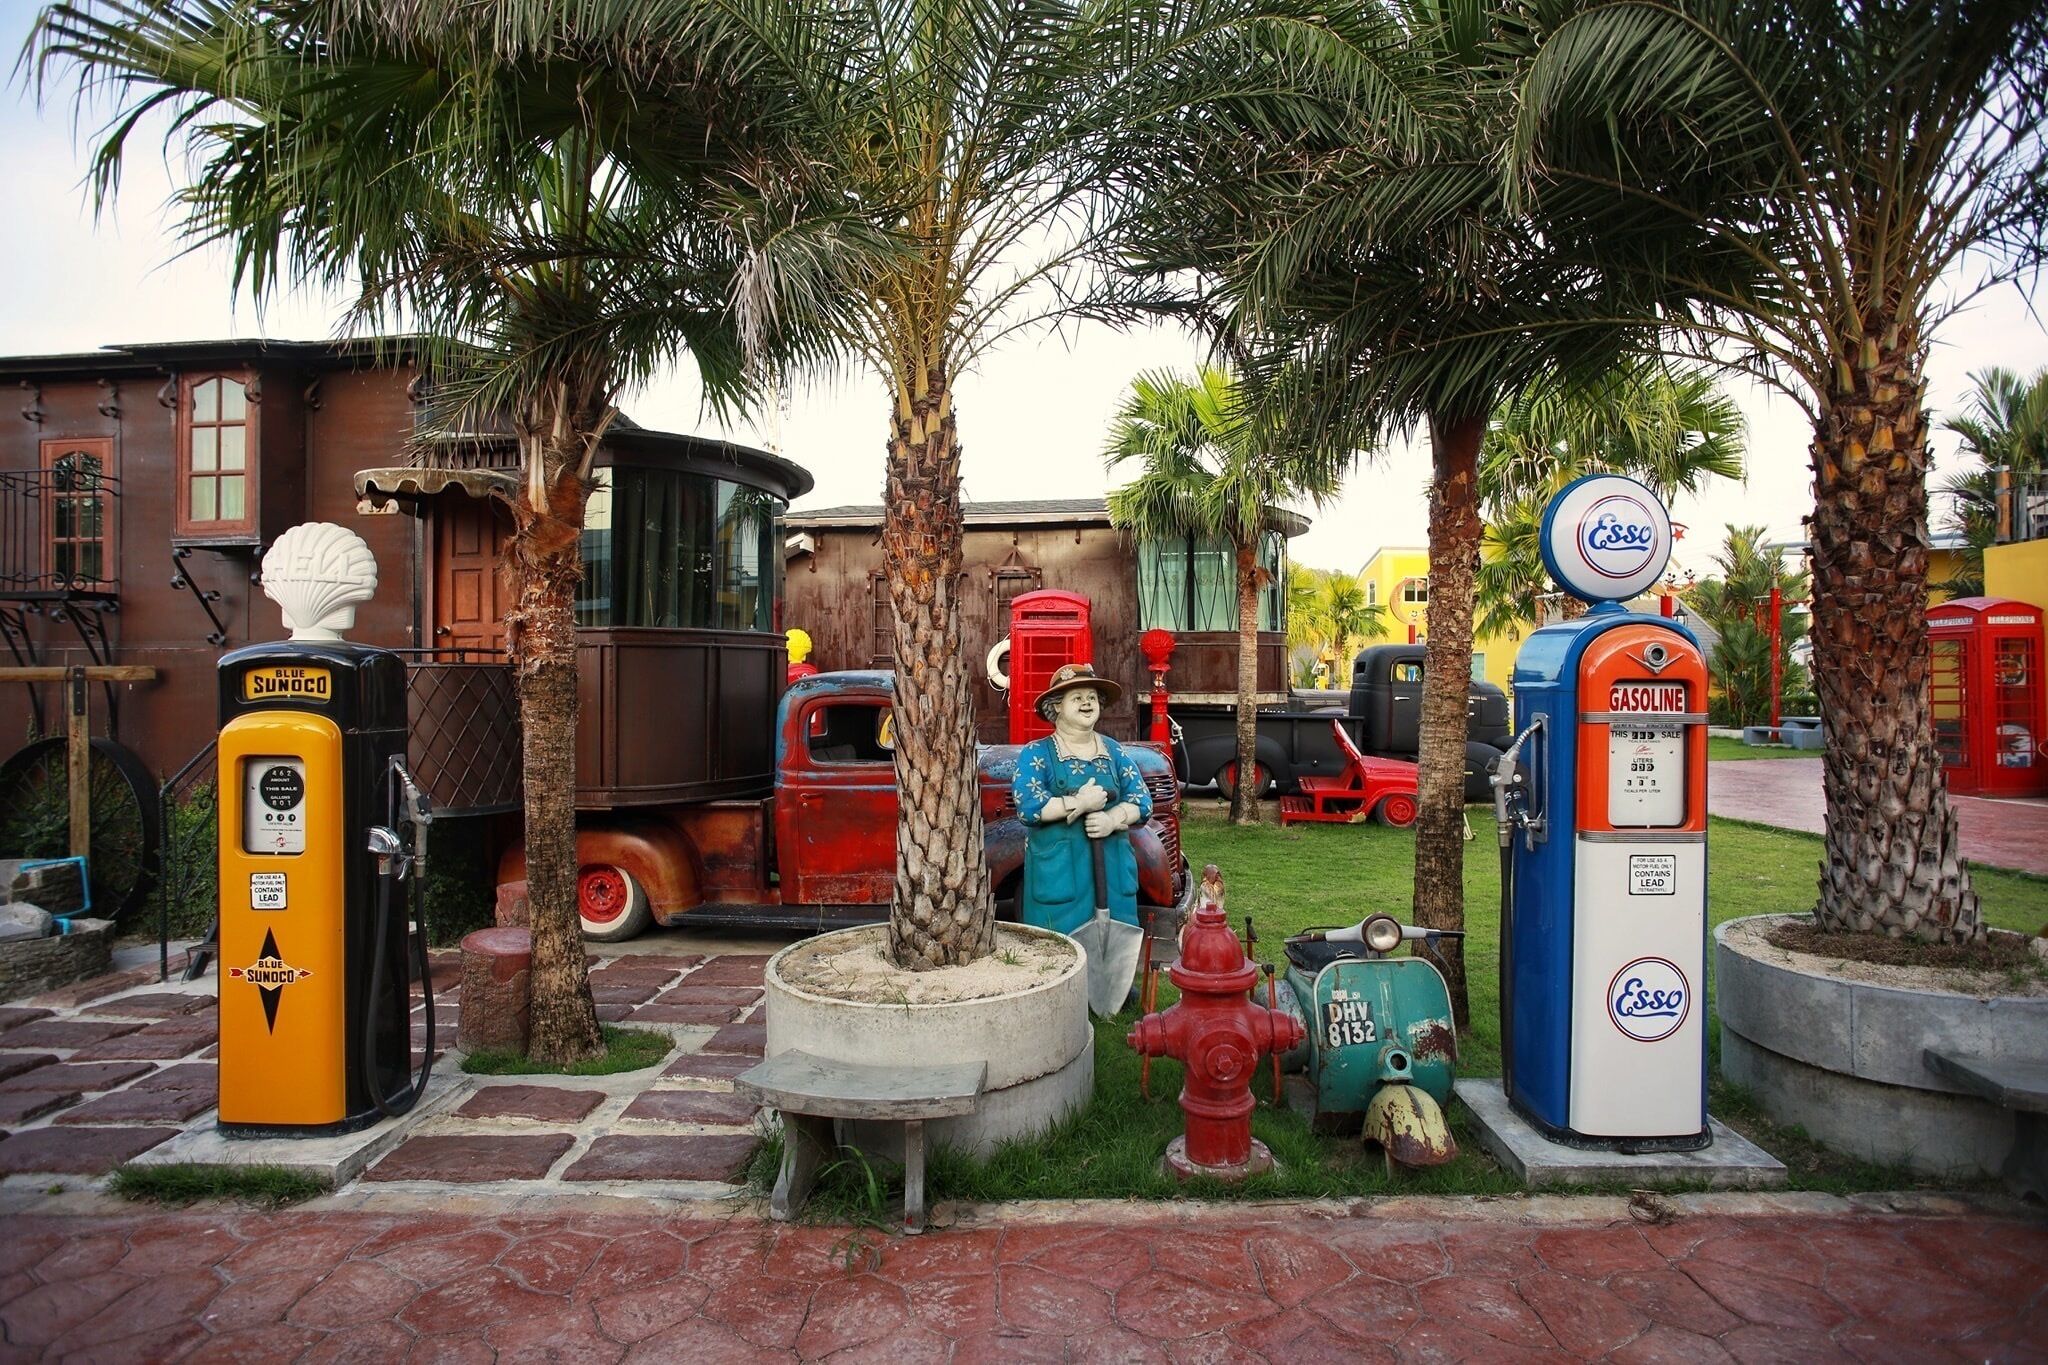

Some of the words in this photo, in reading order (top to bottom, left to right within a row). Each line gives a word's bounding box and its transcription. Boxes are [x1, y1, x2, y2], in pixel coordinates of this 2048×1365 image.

[1588, 513, 1652, 552] Esso
[1990, 616, 2034, 624] TELEPHONE
[275, 669, 305, 678] BLUE
[253, 675, 327, 694] SUNOCO
[1609, 687, 1683, 712] GASOLINE
[1611, 730, 1628, 738] THIS
[1661, 730, 1681, 739] SALE
[1634, 870, 1671, 878] CONTAINS
[1640, 879, 1665, 887] LEAD
[259, 893, 279, 902] LEAD
[258, 960, 283, 969] BLUE
[247, 969, 294, 983] SUNOCO
[1616, 977, 1683, 1018] Esso
[1329, 1001, 1368, 1023] DHV
[1328, 1020, 1376, 1048] 8132
